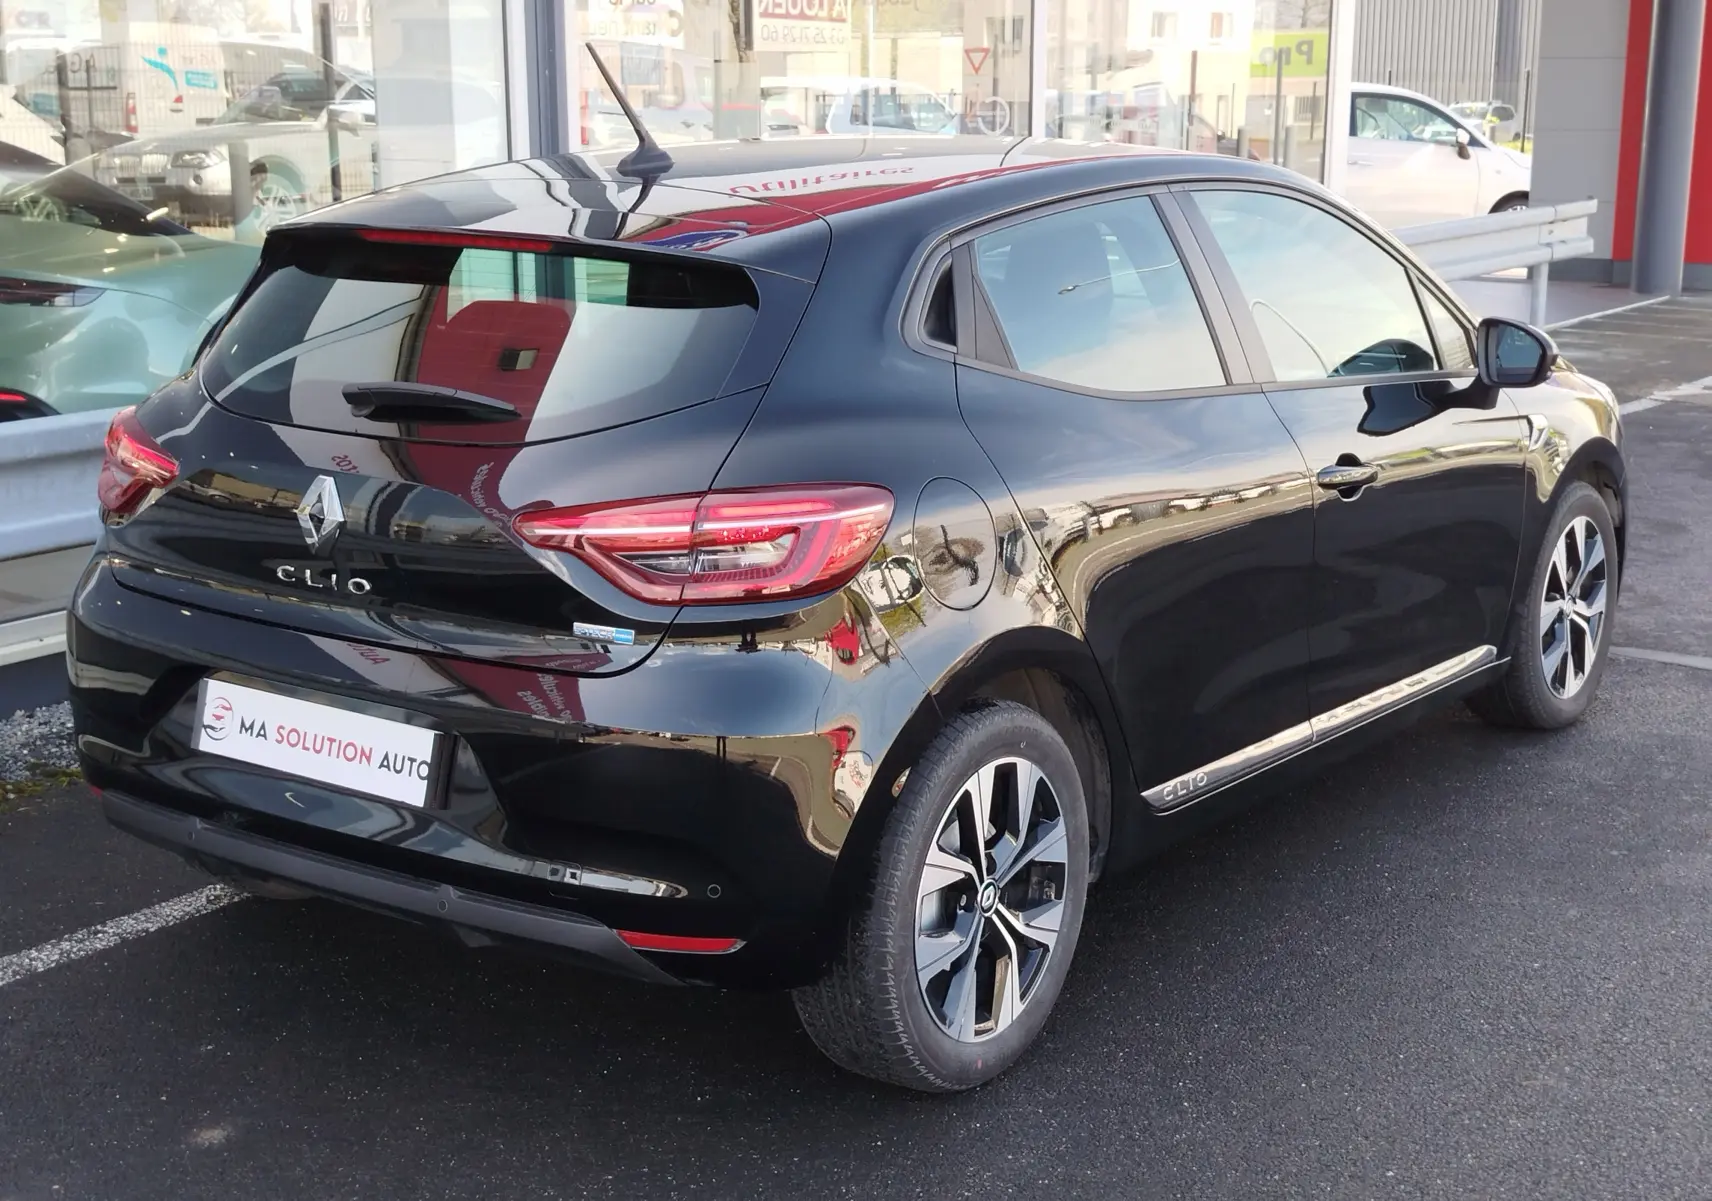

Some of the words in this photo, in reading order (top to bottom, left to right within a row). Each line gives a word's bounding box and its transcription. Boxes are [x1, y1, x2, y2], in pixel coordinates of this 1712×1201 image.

[276, 565, 372, 595] CLIO
[238, 716, 268, 741] MA
[274, 724, 373, 766] SOLUTION
[377, 750, 432, 781] AUTO
[1162, 772, 1208, 801] CLIO
